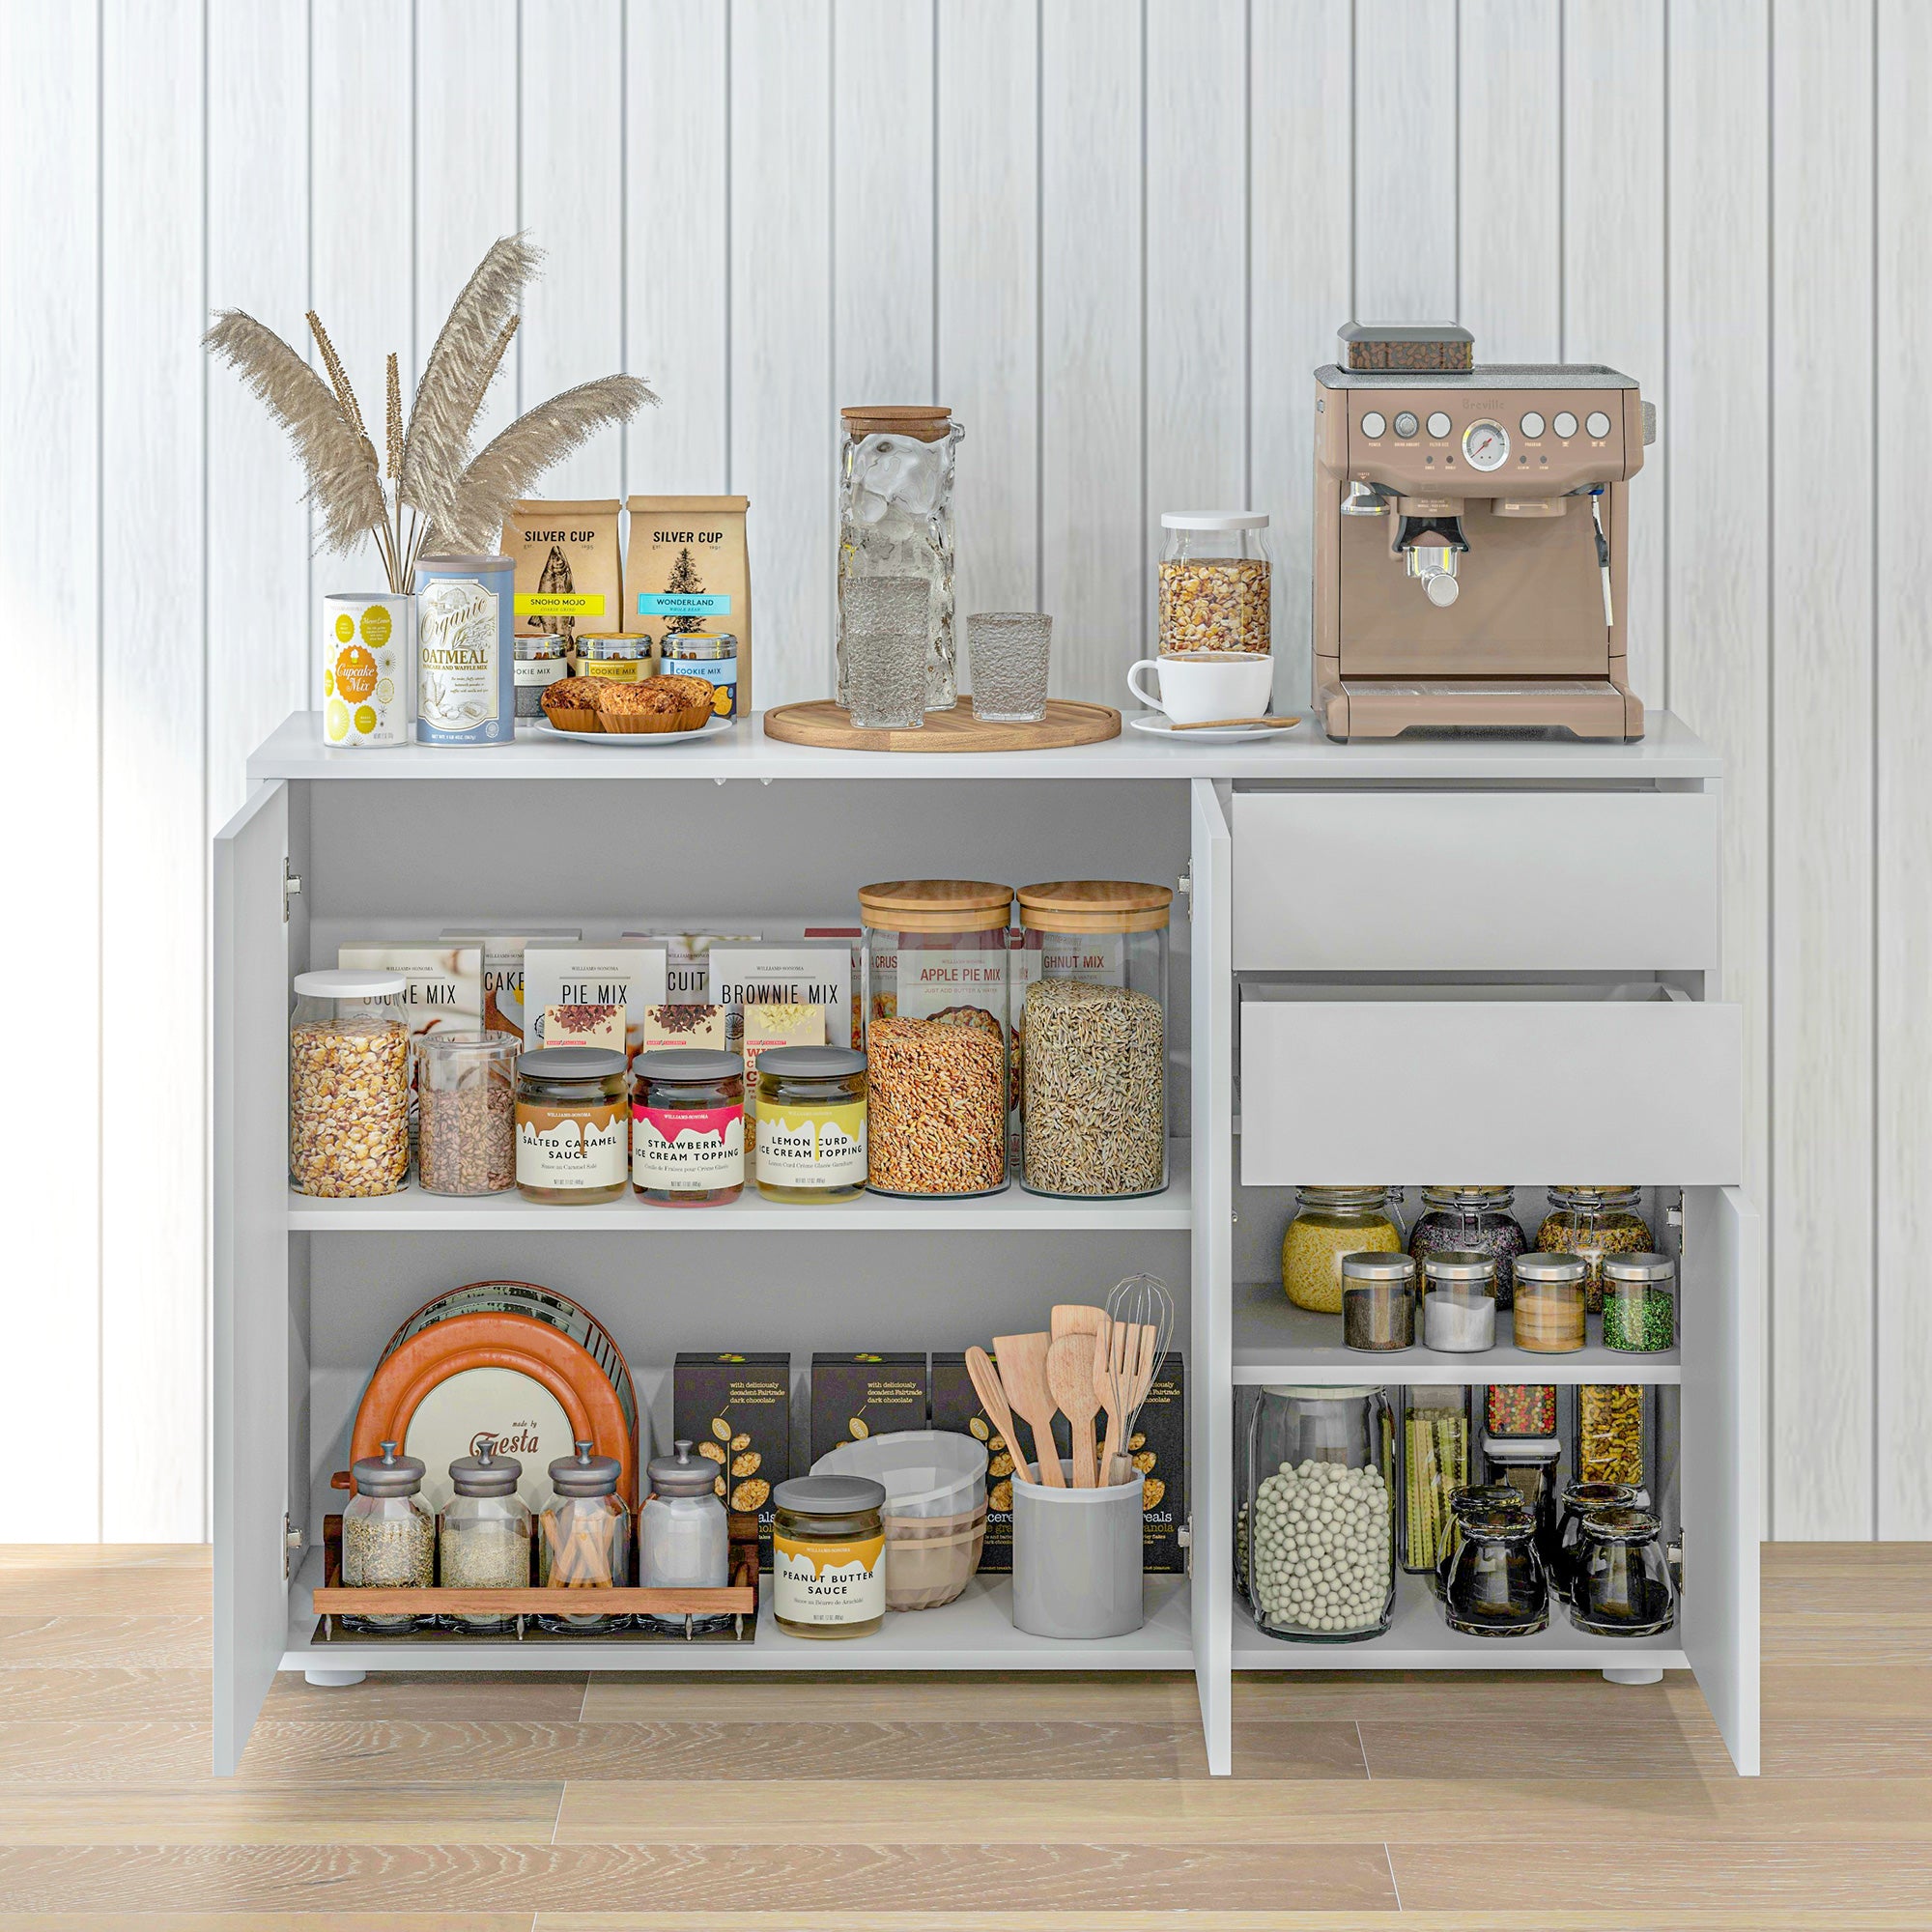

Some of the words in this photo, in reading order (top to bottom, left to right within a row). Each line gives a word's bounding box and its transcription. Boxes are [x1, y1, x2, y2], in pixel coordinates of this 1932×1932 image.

[1463, 398, 1504, 410] Breville
[525, 530, 566, 542] SILVER
[570, 530, 595, 542] CUP
[653, 531, 695, 543] SILVER
[698, 531, 724, 543] CUP
[421, 596, 487, 648] Organic
[422, 648, 489, 664] OATMEAL
[336, 663, 375, 681] Cupcake
[347, 677, 370, 693] Mix
[1083, 955, 1105, 968] MIX
[668, 971, 706, 991] CUIT
[920, 968, 959, 981] APPLE
[962, 968, 980, 981] PIE
[983, 968, 1001, 981] MIX
[426, 984, 456, 1005] MIX
[562, 984, 588, 1004] PIE
[598, 984, 628, 1004] MIX
[722, 984, 799, 1005] BROWNIE
[809, 984, 838, 1004] MIX
[523, 1135, 559, 1148] SALTED
[565, 1136, 617, 1148] CARAMEL
[647, 1139, 724, 1150] STRAWBERRY
[772, 1136, 810, 1147] LEMON
[817, 1136, 848, 1147] CURD
[548, 1151, 588, 1159] SAUCE
[635, 1148, 646, 1158] ICE
[649, 1151, 688, 1161] CREAM
[694, 1148, 739, 1161] TOPPING
[758, 1144, 771, 1154] ICE
[773, 1148, 812, 1158] CREAM
[819, 1145, 863, 1158] TOPPING
[782, 1570, 826, 1583] PEANUT
[831, 1571, 874, 1583] BUTTER
[808, 1585, 848, 1595] SAUCE
